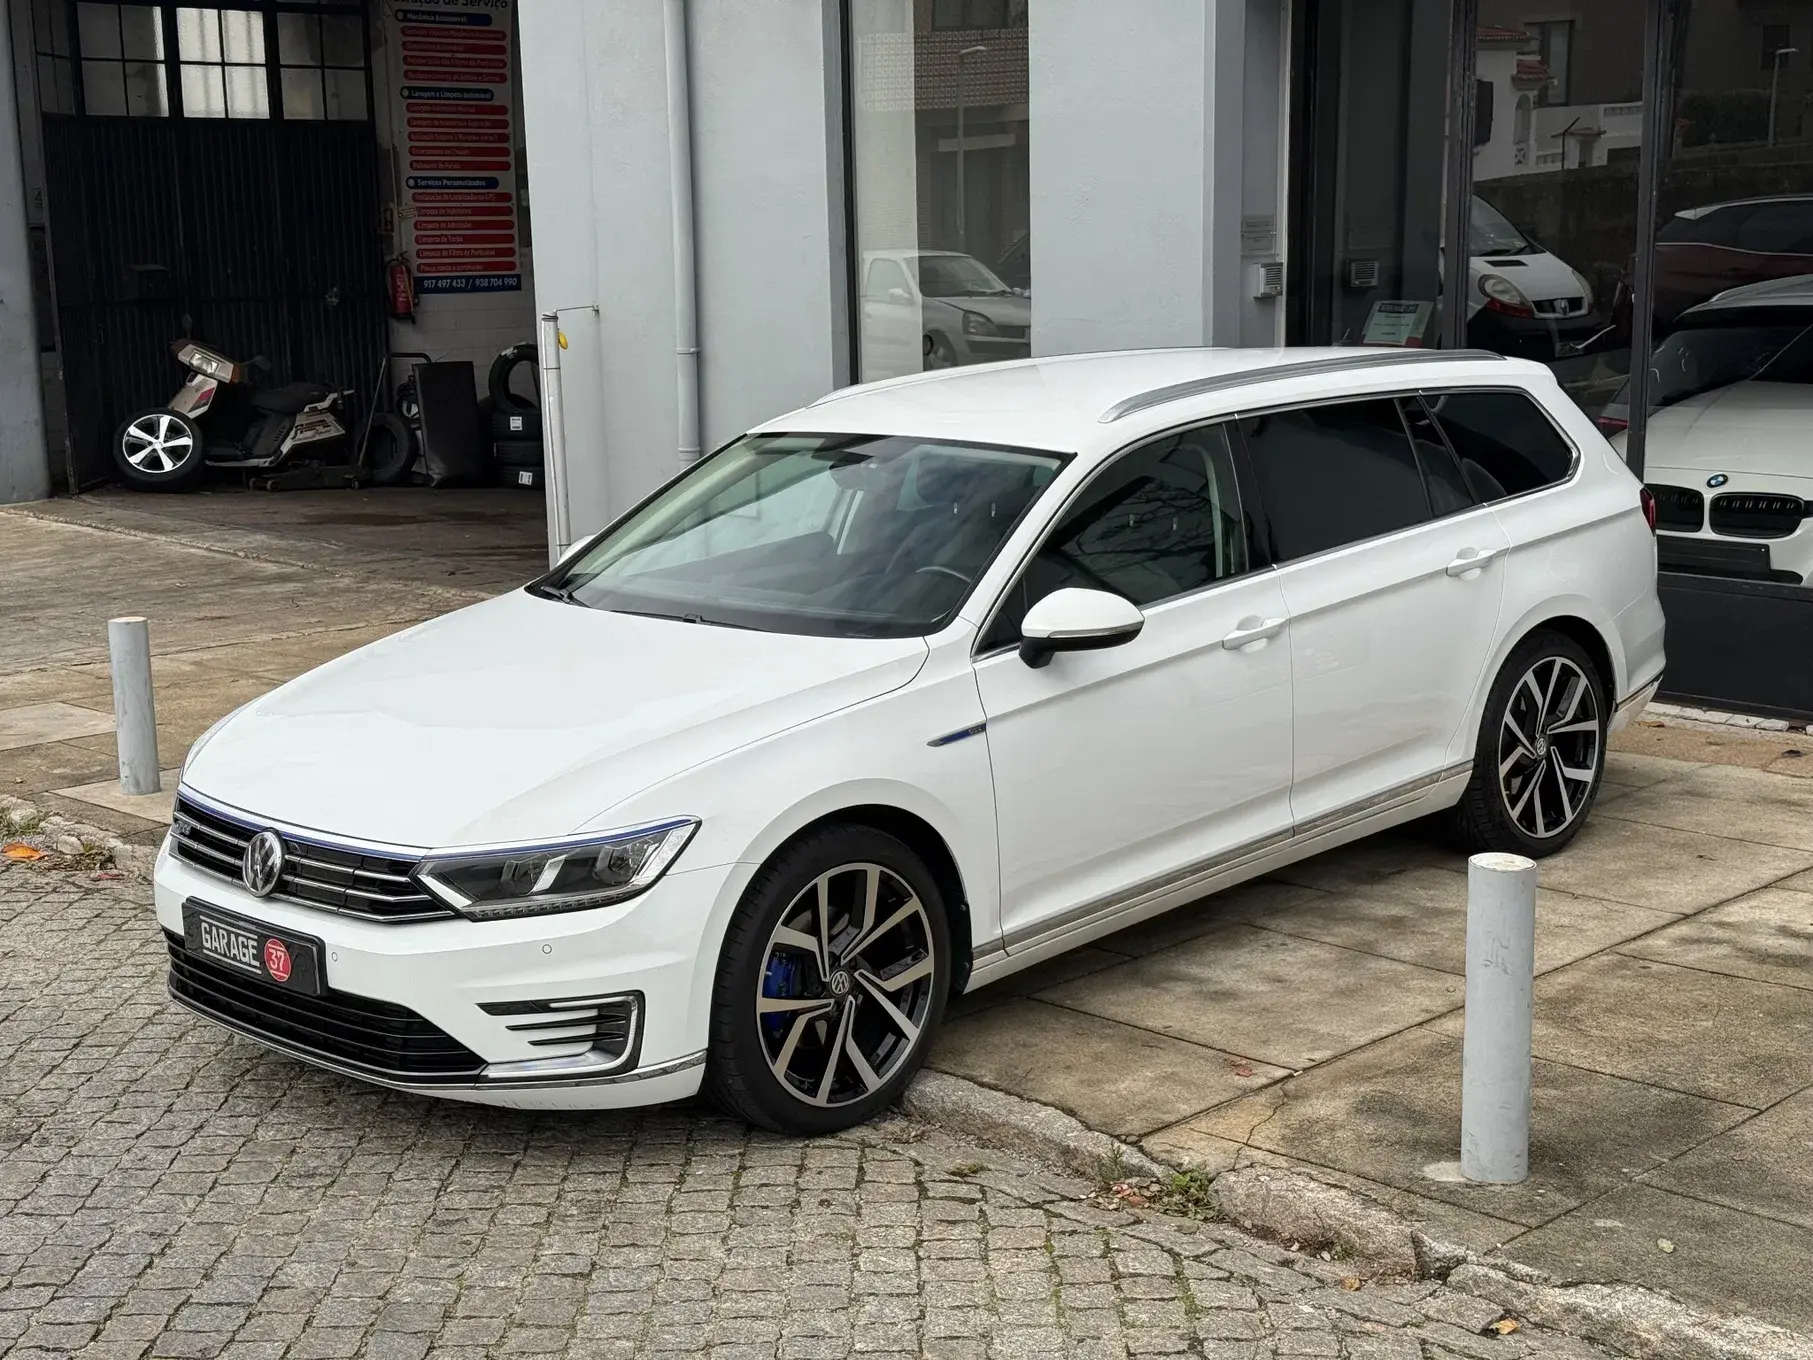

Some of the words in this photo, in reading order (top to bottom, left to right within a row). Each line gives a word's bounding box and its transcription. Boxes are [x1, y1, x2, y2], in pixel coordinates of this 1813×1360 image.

[412, 90, 436, 98] Lavagem
[440, 90, 462, 99] Limpeza
[442, 179, 486, 187] Personalizados
[424, 280, 436, 288] 917
[437, 279, 450, 288] 497
[452, 279, 466, 287] 433
[475, 278, 488, 287] 938
[489, 278, 502, 286] 704
[504, 277, 518, 286] 990
[201, 922, 260, 967] GARAGE
[268, 949, 285, 972] 37
